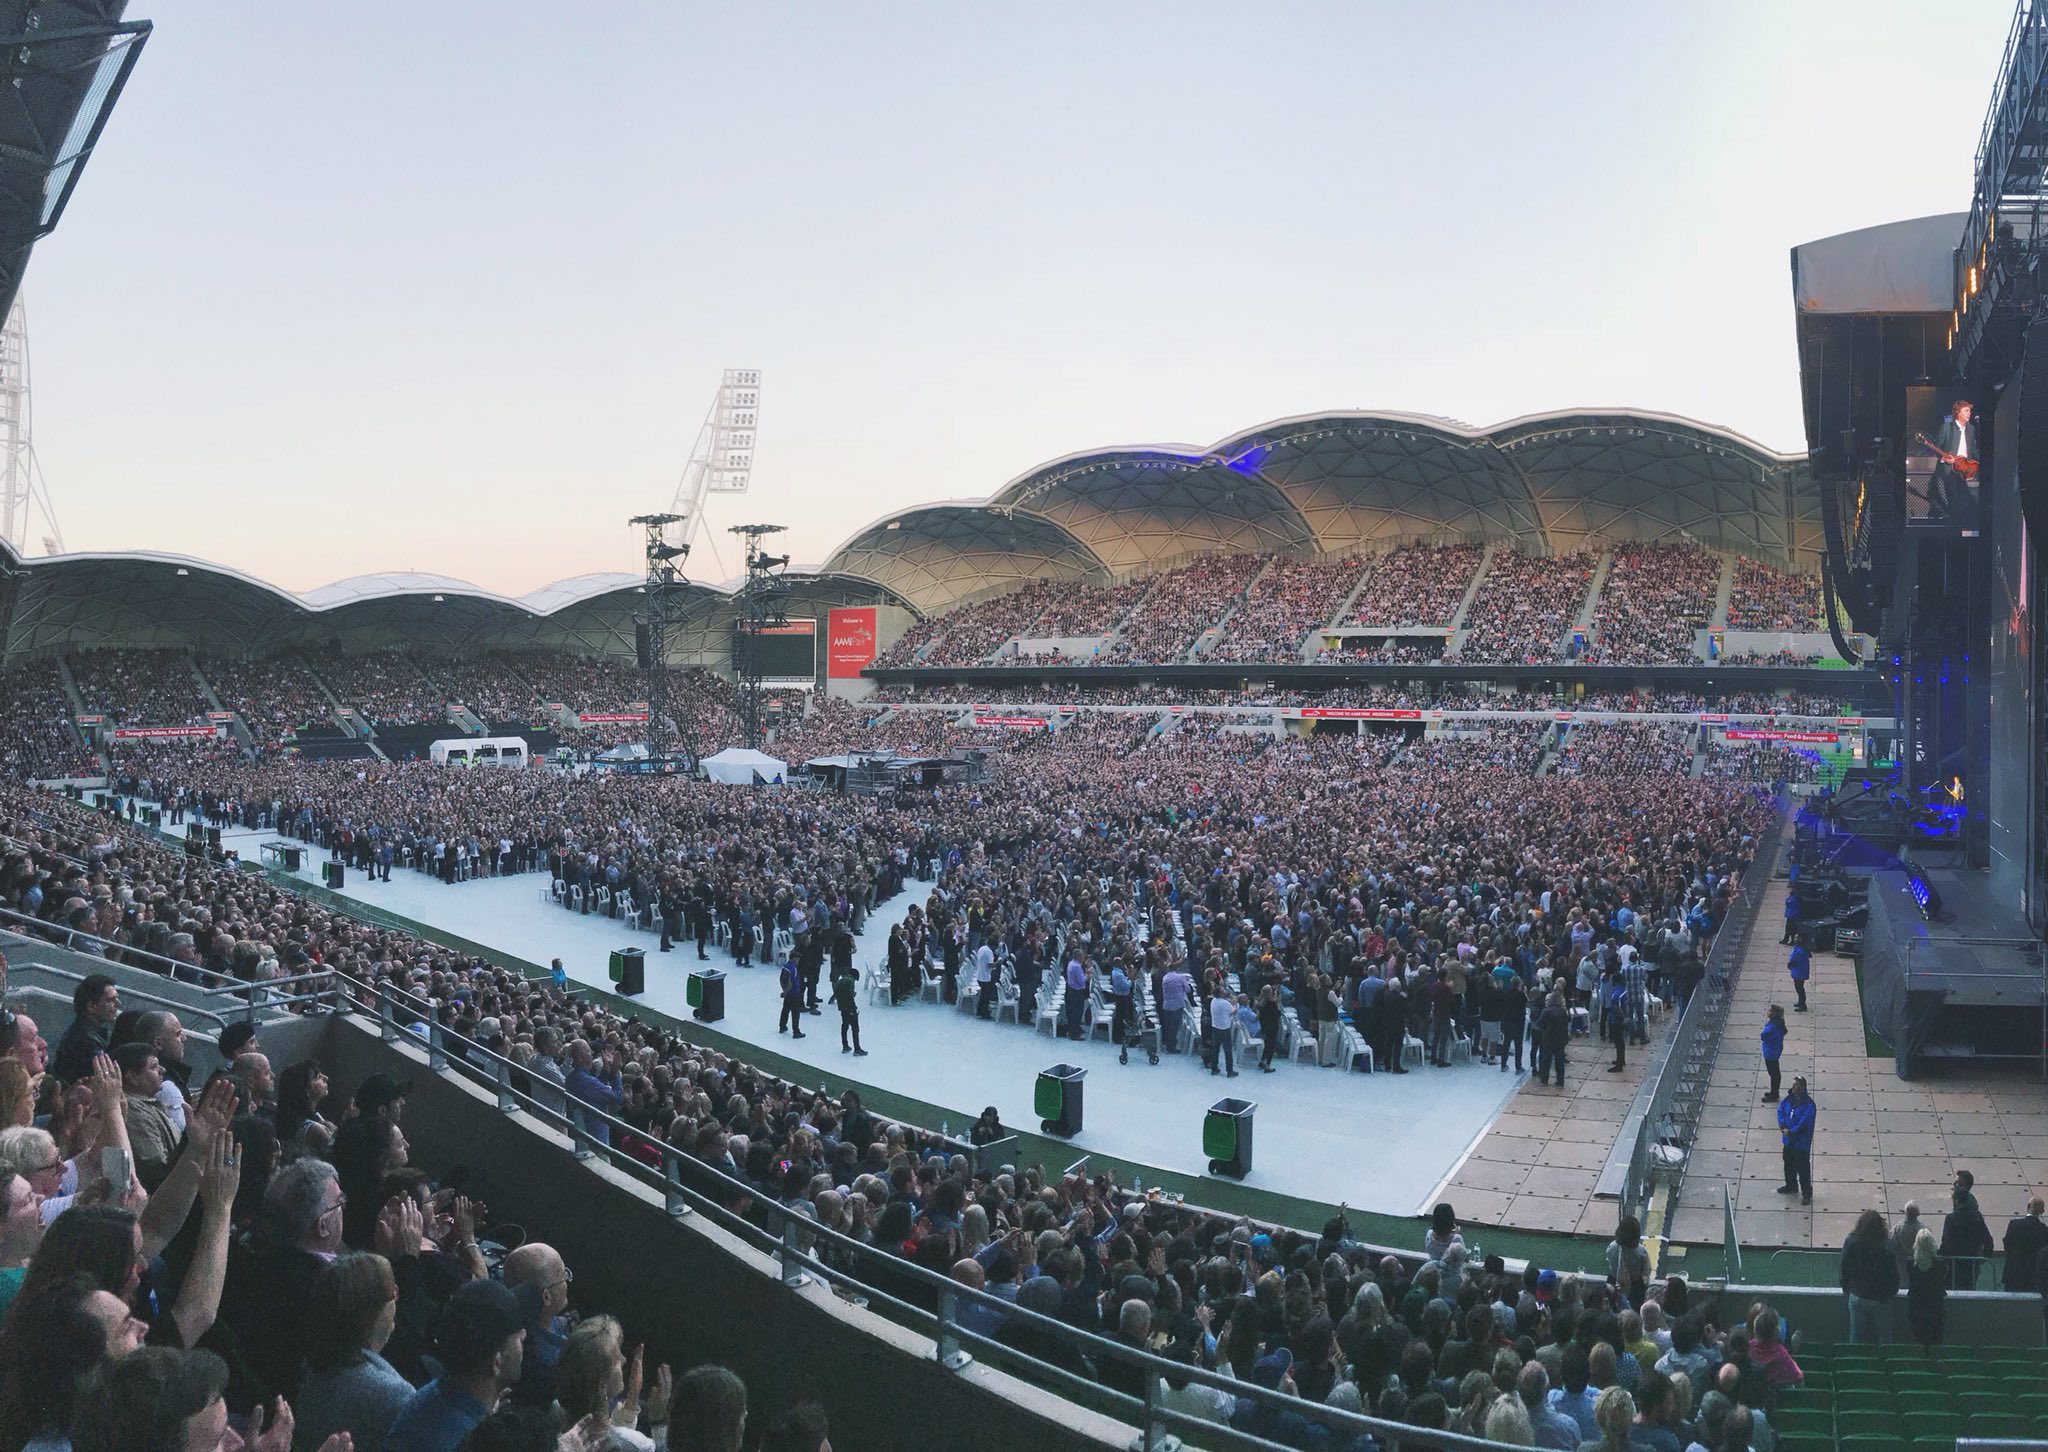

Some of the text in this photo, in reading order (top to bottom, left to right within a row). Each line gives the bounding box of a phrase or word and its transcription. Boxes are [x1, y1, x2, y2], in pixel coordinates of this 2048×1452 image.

[125, 730, 144, 738] Through
[1737, 732, 1758, 740] Through
[1802, 734, 1828, 743] Beverages
